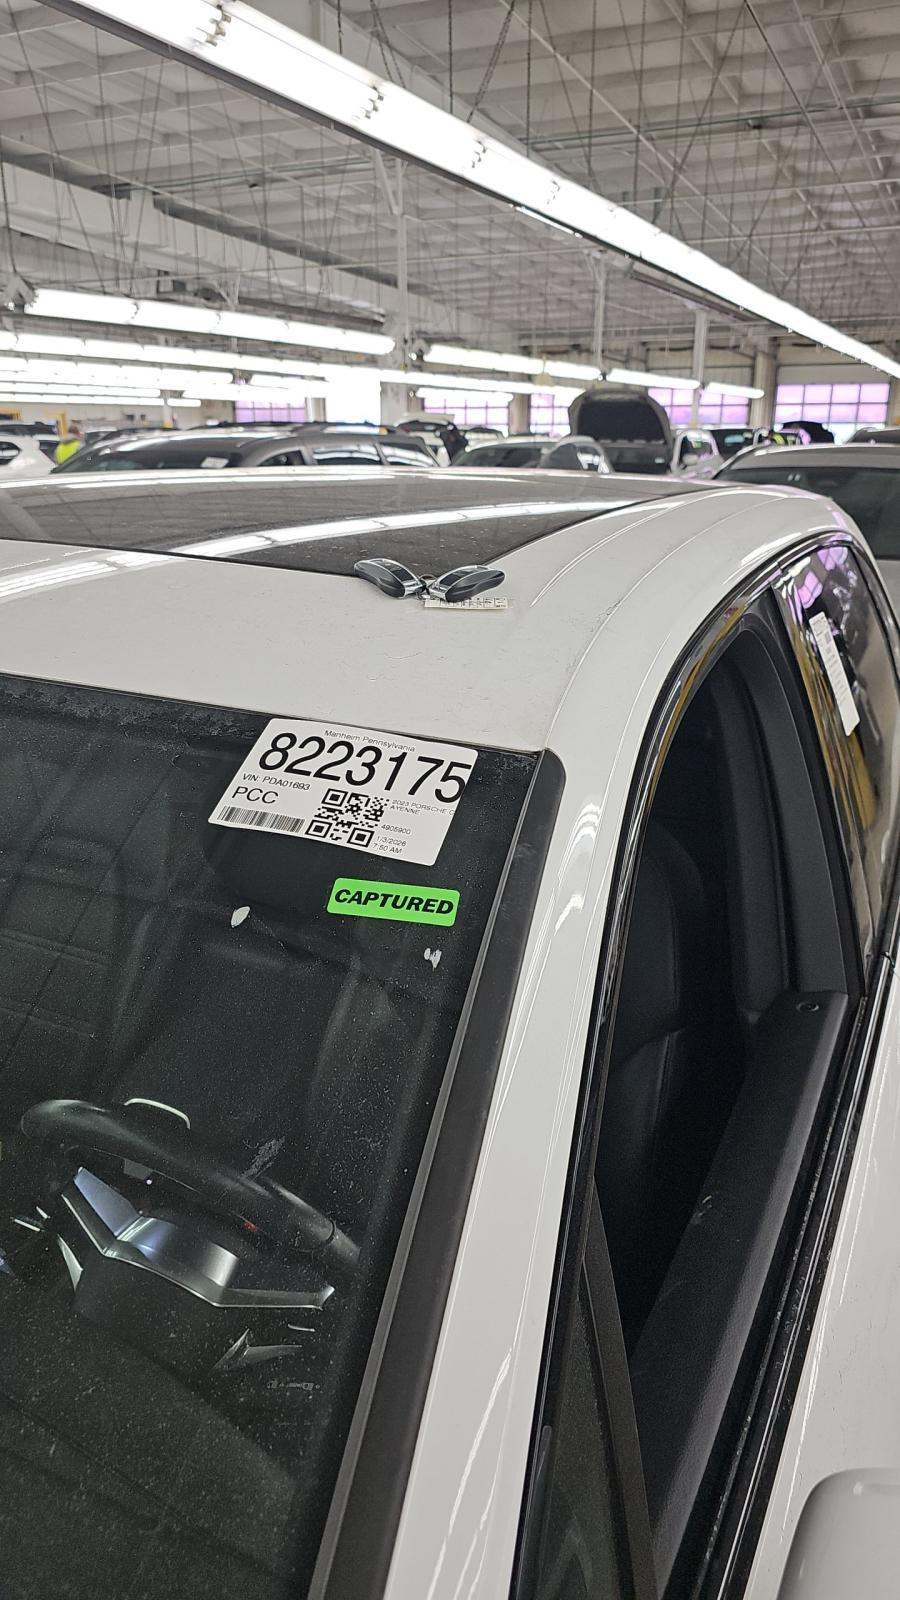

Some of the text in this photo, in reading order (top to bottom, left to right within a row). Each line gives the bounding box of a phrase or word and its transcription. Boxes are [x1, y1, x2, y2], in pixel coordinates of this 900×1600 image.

[325, 730, 416, 753] Manheim Pennsylvania
[258, 732, 472, 804] 8223175
[242, 773, 311, 792] VIN: PDA01693
[231, 786, 279, 804] PCC
[389, 805, 421, 815] AYENNE
[392, 799, 410, 807] 2023
[410, 803, 447, 814] PORSCHE
[389, 846, 403, 854] AM
[334, 888, 454, 916] CAPTURED
